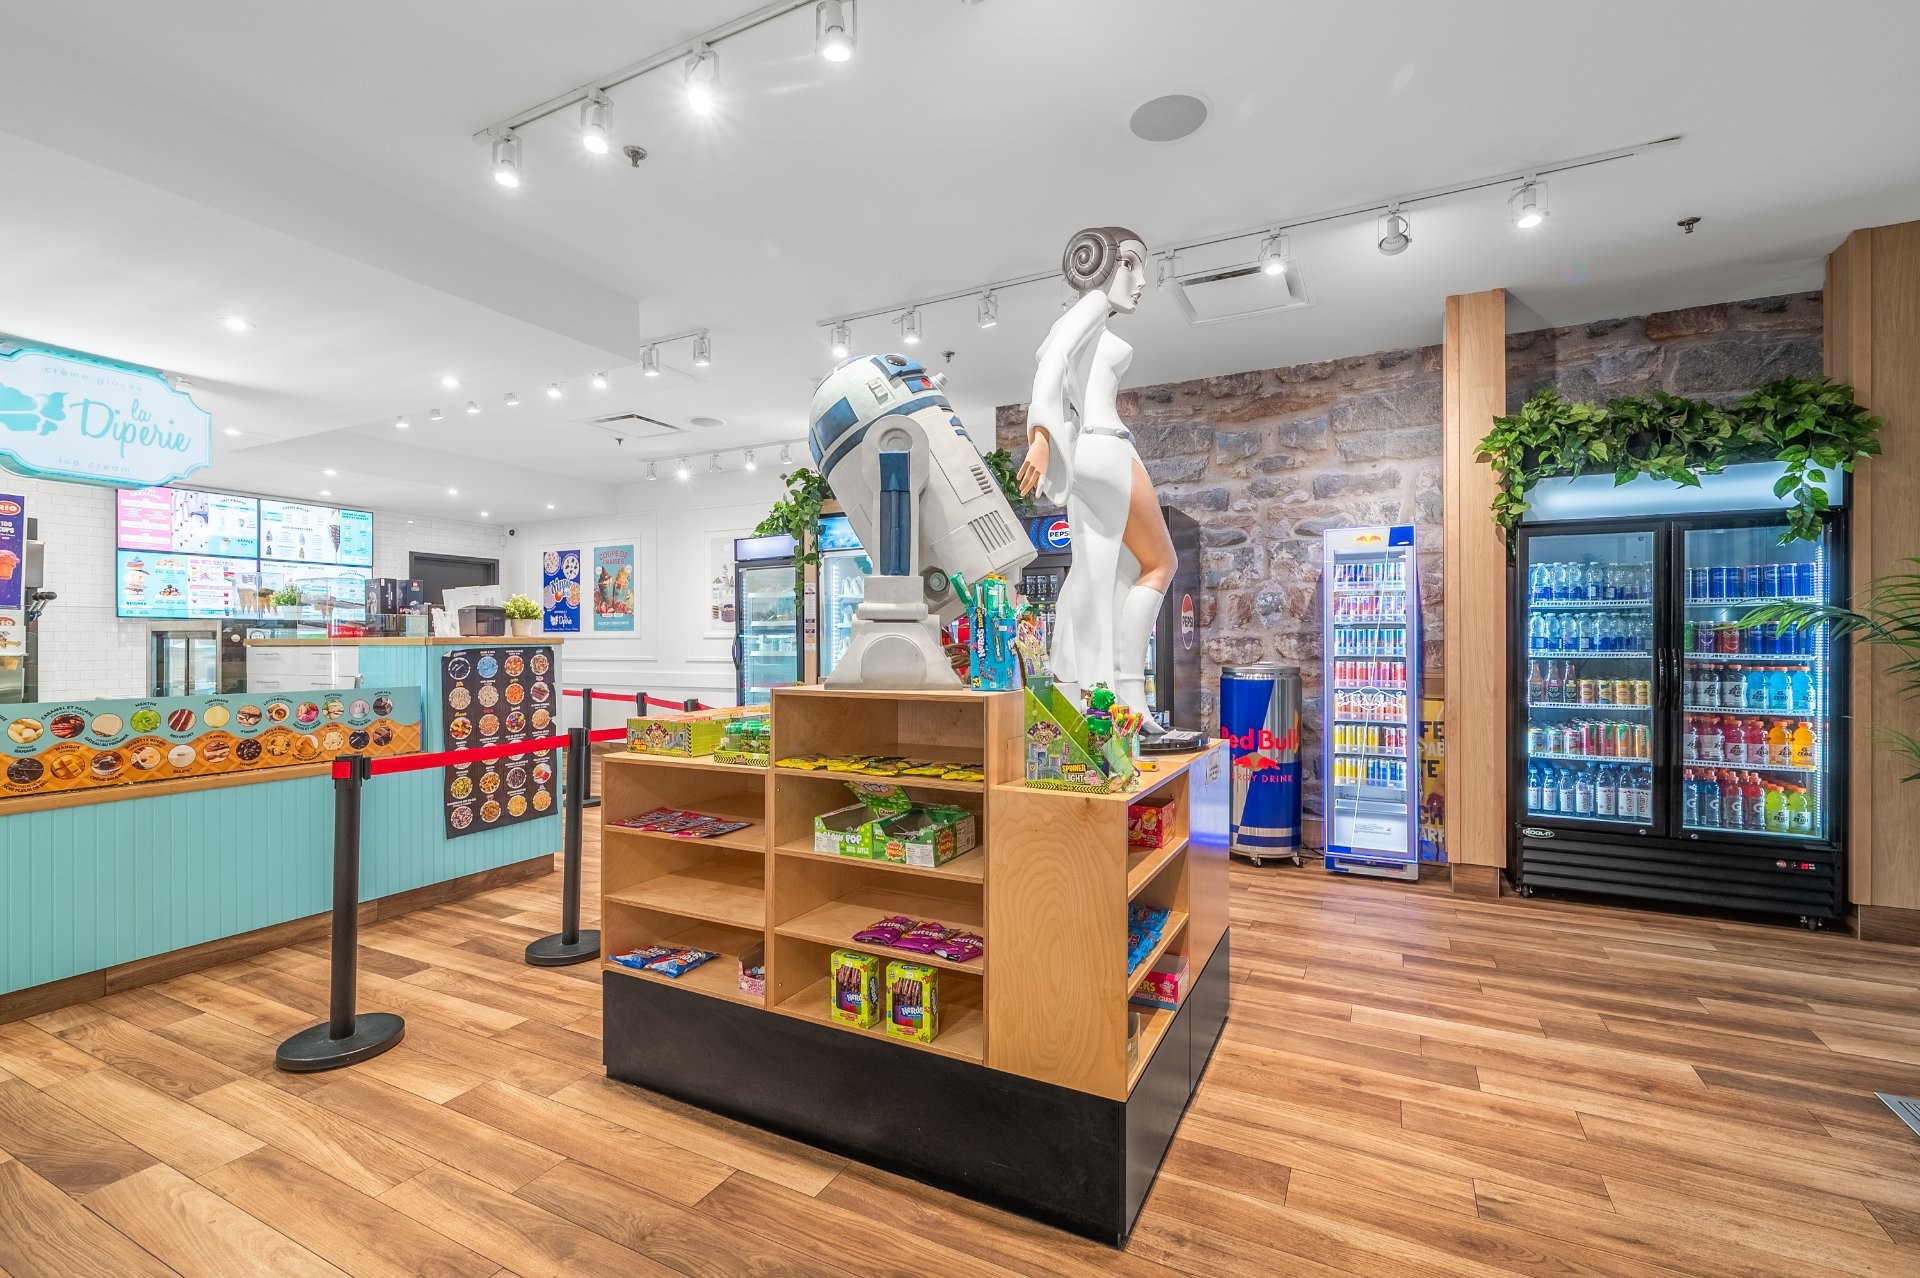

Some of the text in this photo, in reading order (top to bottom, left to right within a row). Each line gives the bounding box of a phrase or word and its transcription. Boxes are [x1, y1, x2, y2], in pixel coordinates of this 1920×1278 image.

[131, 398, 152, 422] la
[69, 397, 191, 459] Diperie
[58, 456, 130, 473] ice cream
[1050, 530, 1070, 538] PEPS
[599, 549, 629, 561] COUPE DE
[602, 557, 625, 566] FRAISES
[1221, 726, 1297, 751] Red Bull
[1231, 772, 1258, 782] ERGY
[1261, 774, 1293, 783] DRINK
[845, 834, 862, 844] POP
[1158, 995, 1176, 1004] GUM
